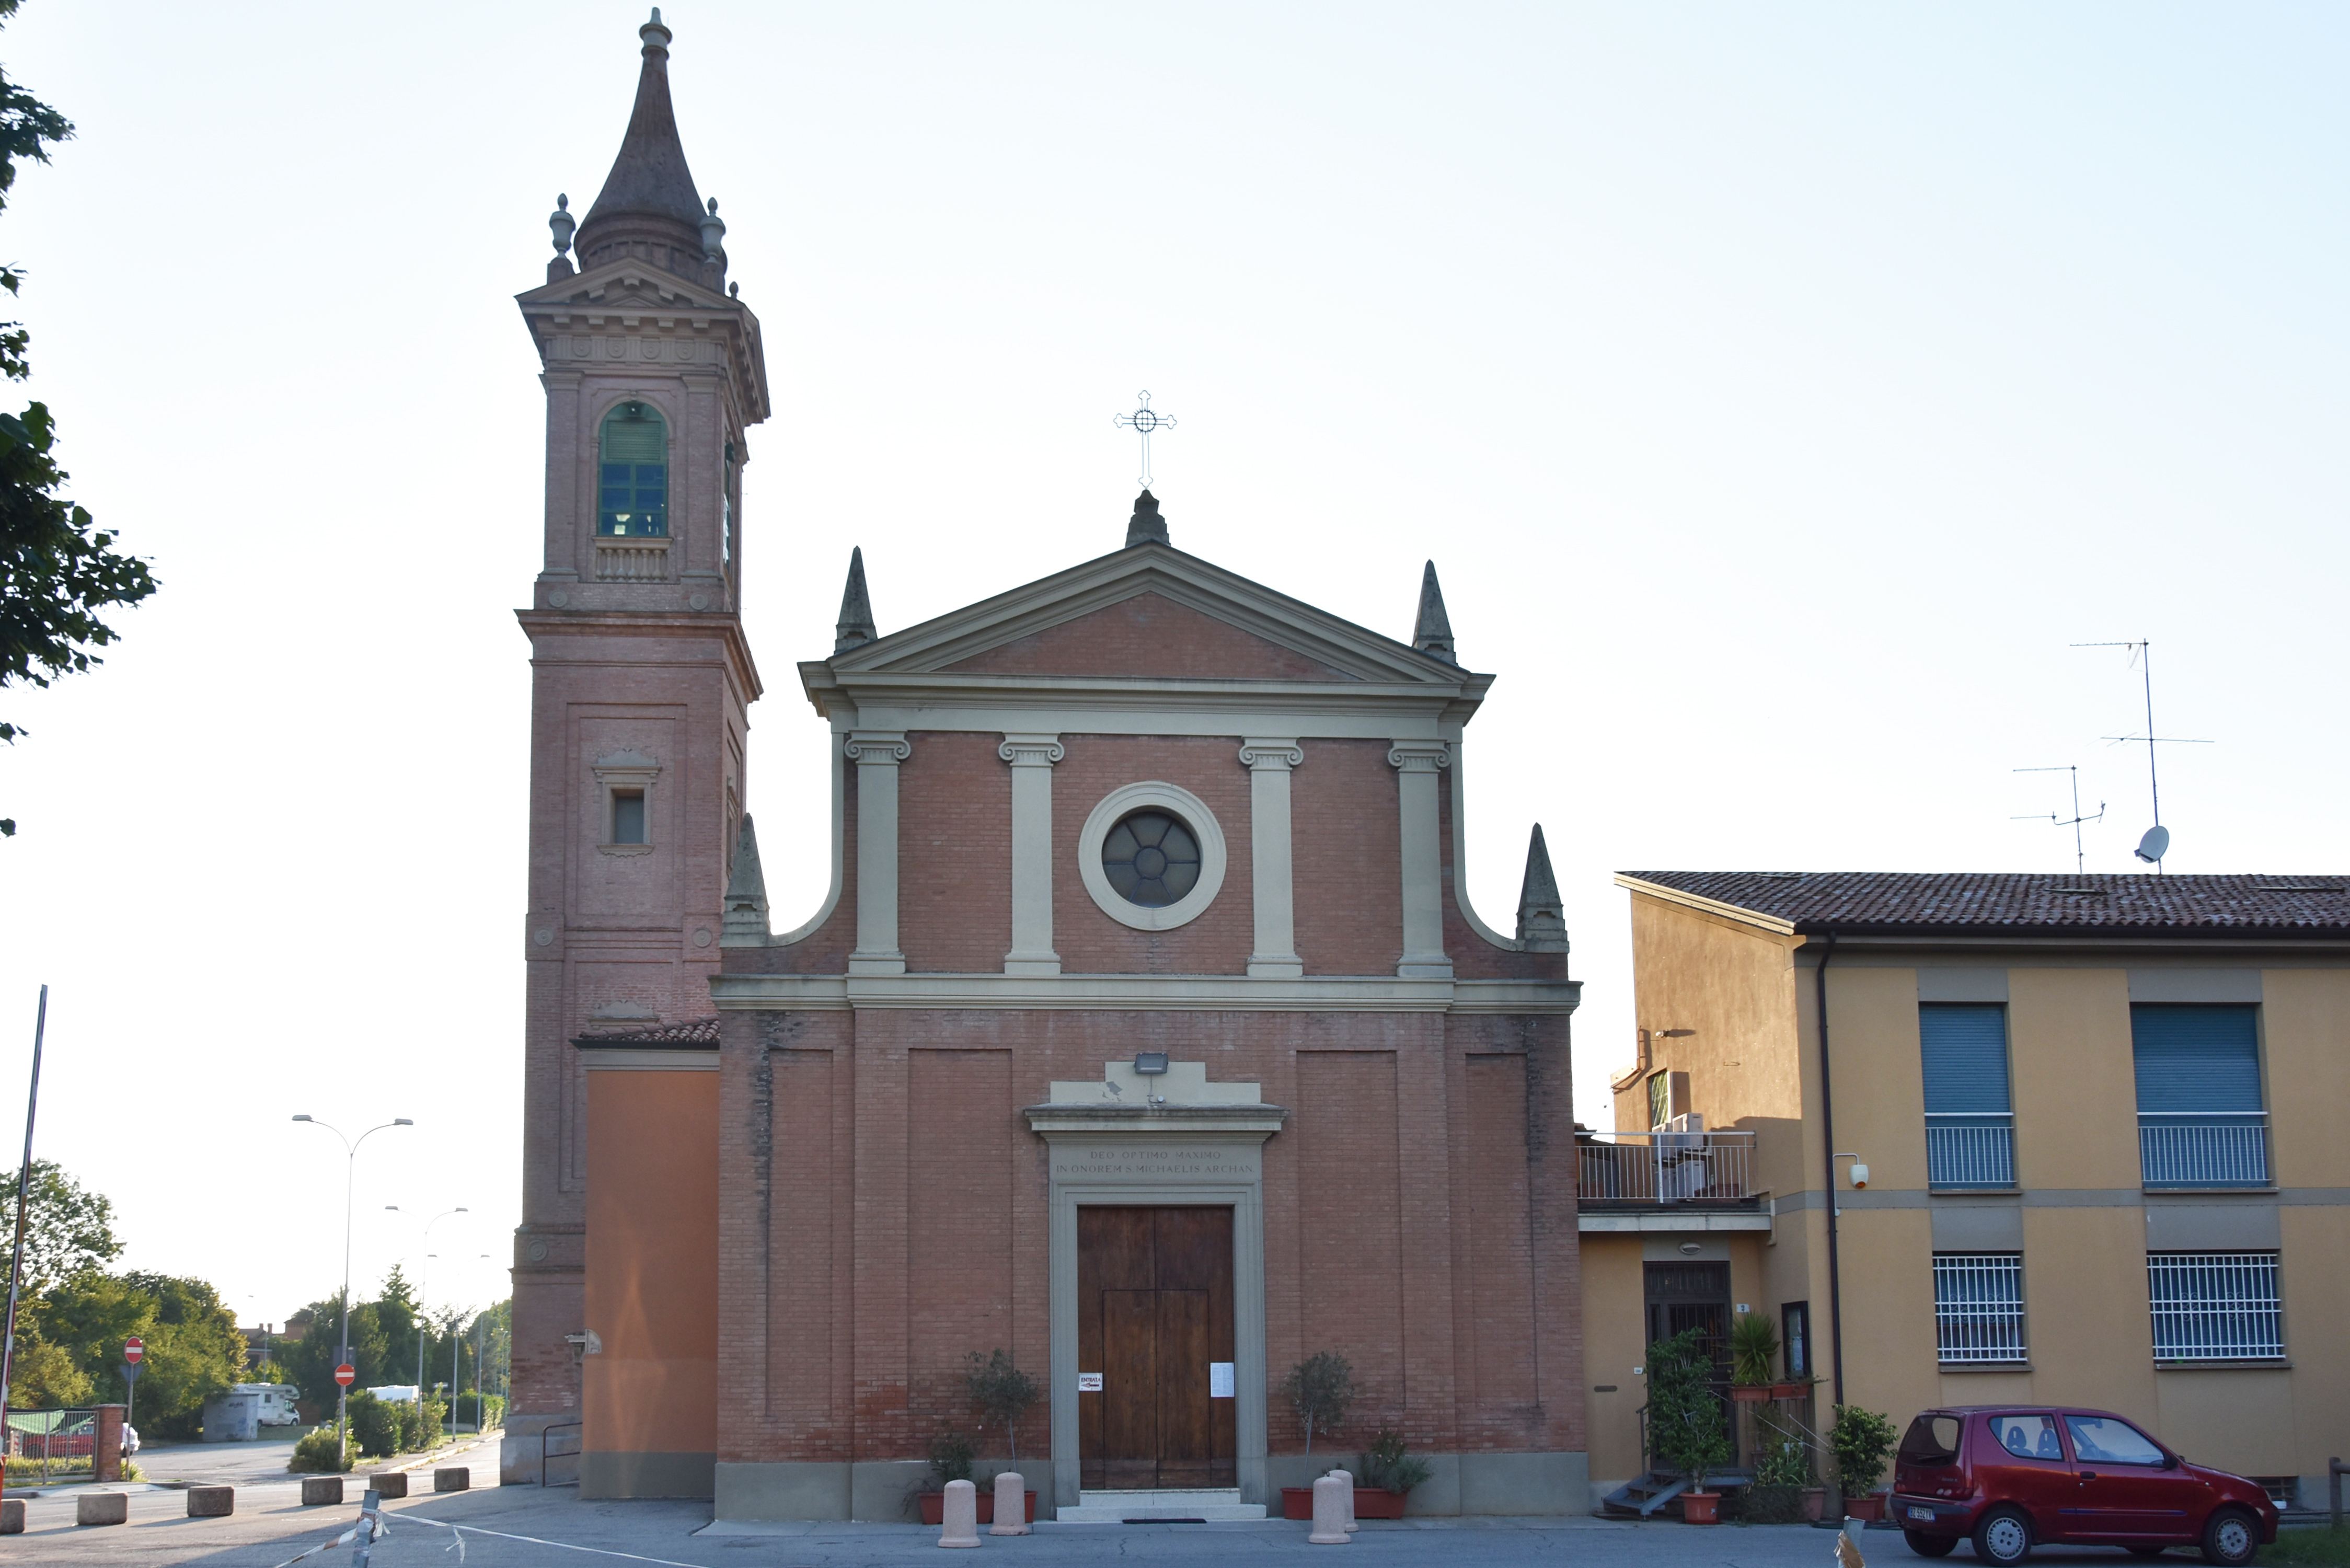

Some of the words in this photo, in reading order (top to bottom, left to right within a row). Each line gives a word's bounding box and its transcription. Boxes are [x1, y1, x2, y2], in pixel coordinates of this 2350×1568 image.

[1090, 1151, 1114, 1159] DEO
[1122, 1151, 1168, 1159] OPTIMO
[1176, 1151, 1221, 1159] MAXIMO
[1056, 1165, 1067, 1173] IN
[1071, 1165, 1122, 1173] ONOREM
[1204, 1165, 1255, 1173] ARCHAN.
